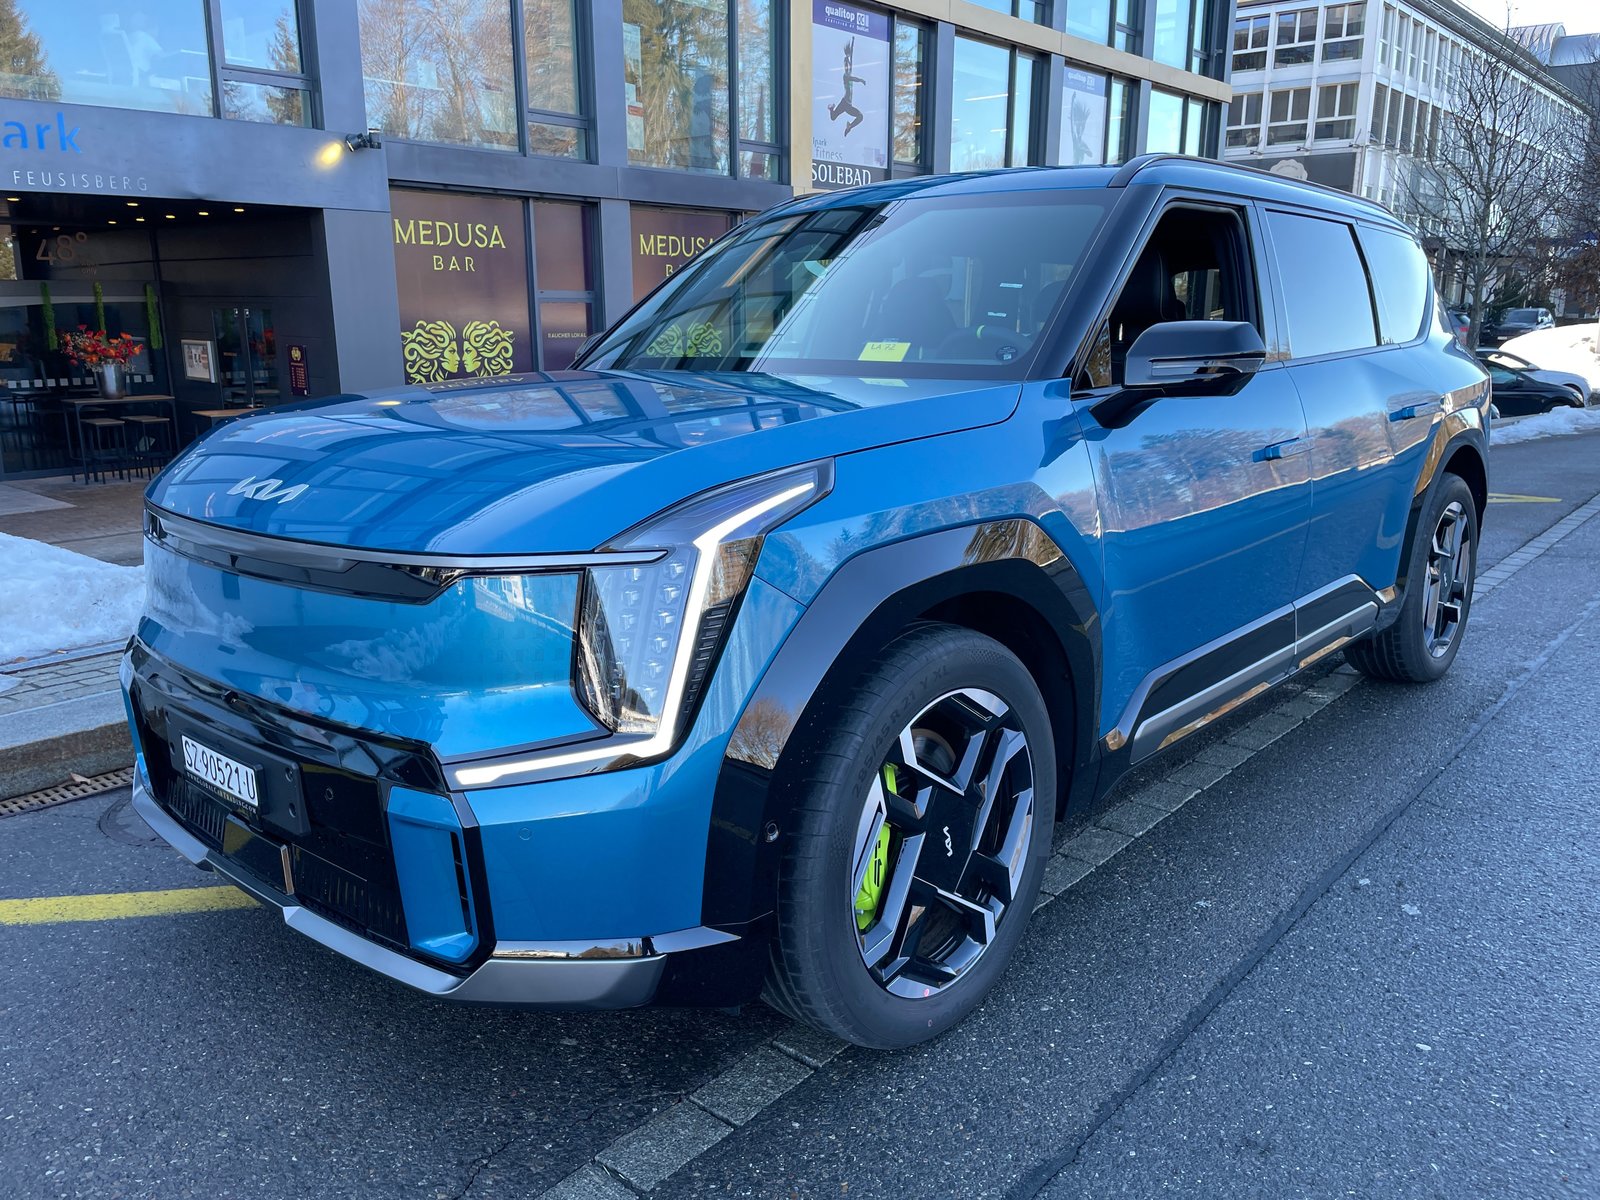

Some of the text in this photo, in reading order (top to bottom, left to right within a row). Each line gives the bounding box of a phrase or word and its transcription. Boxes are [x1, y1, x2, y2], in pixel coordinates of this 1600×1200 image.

[825, 5, 855, 22] qualitop
[816, 146, 843, 161] fitness
[13, 170, 148, 191] FEUSISBERG
[393, 218, 506, 249] MEDUSA
[433, 255, 476, 272] BAR
